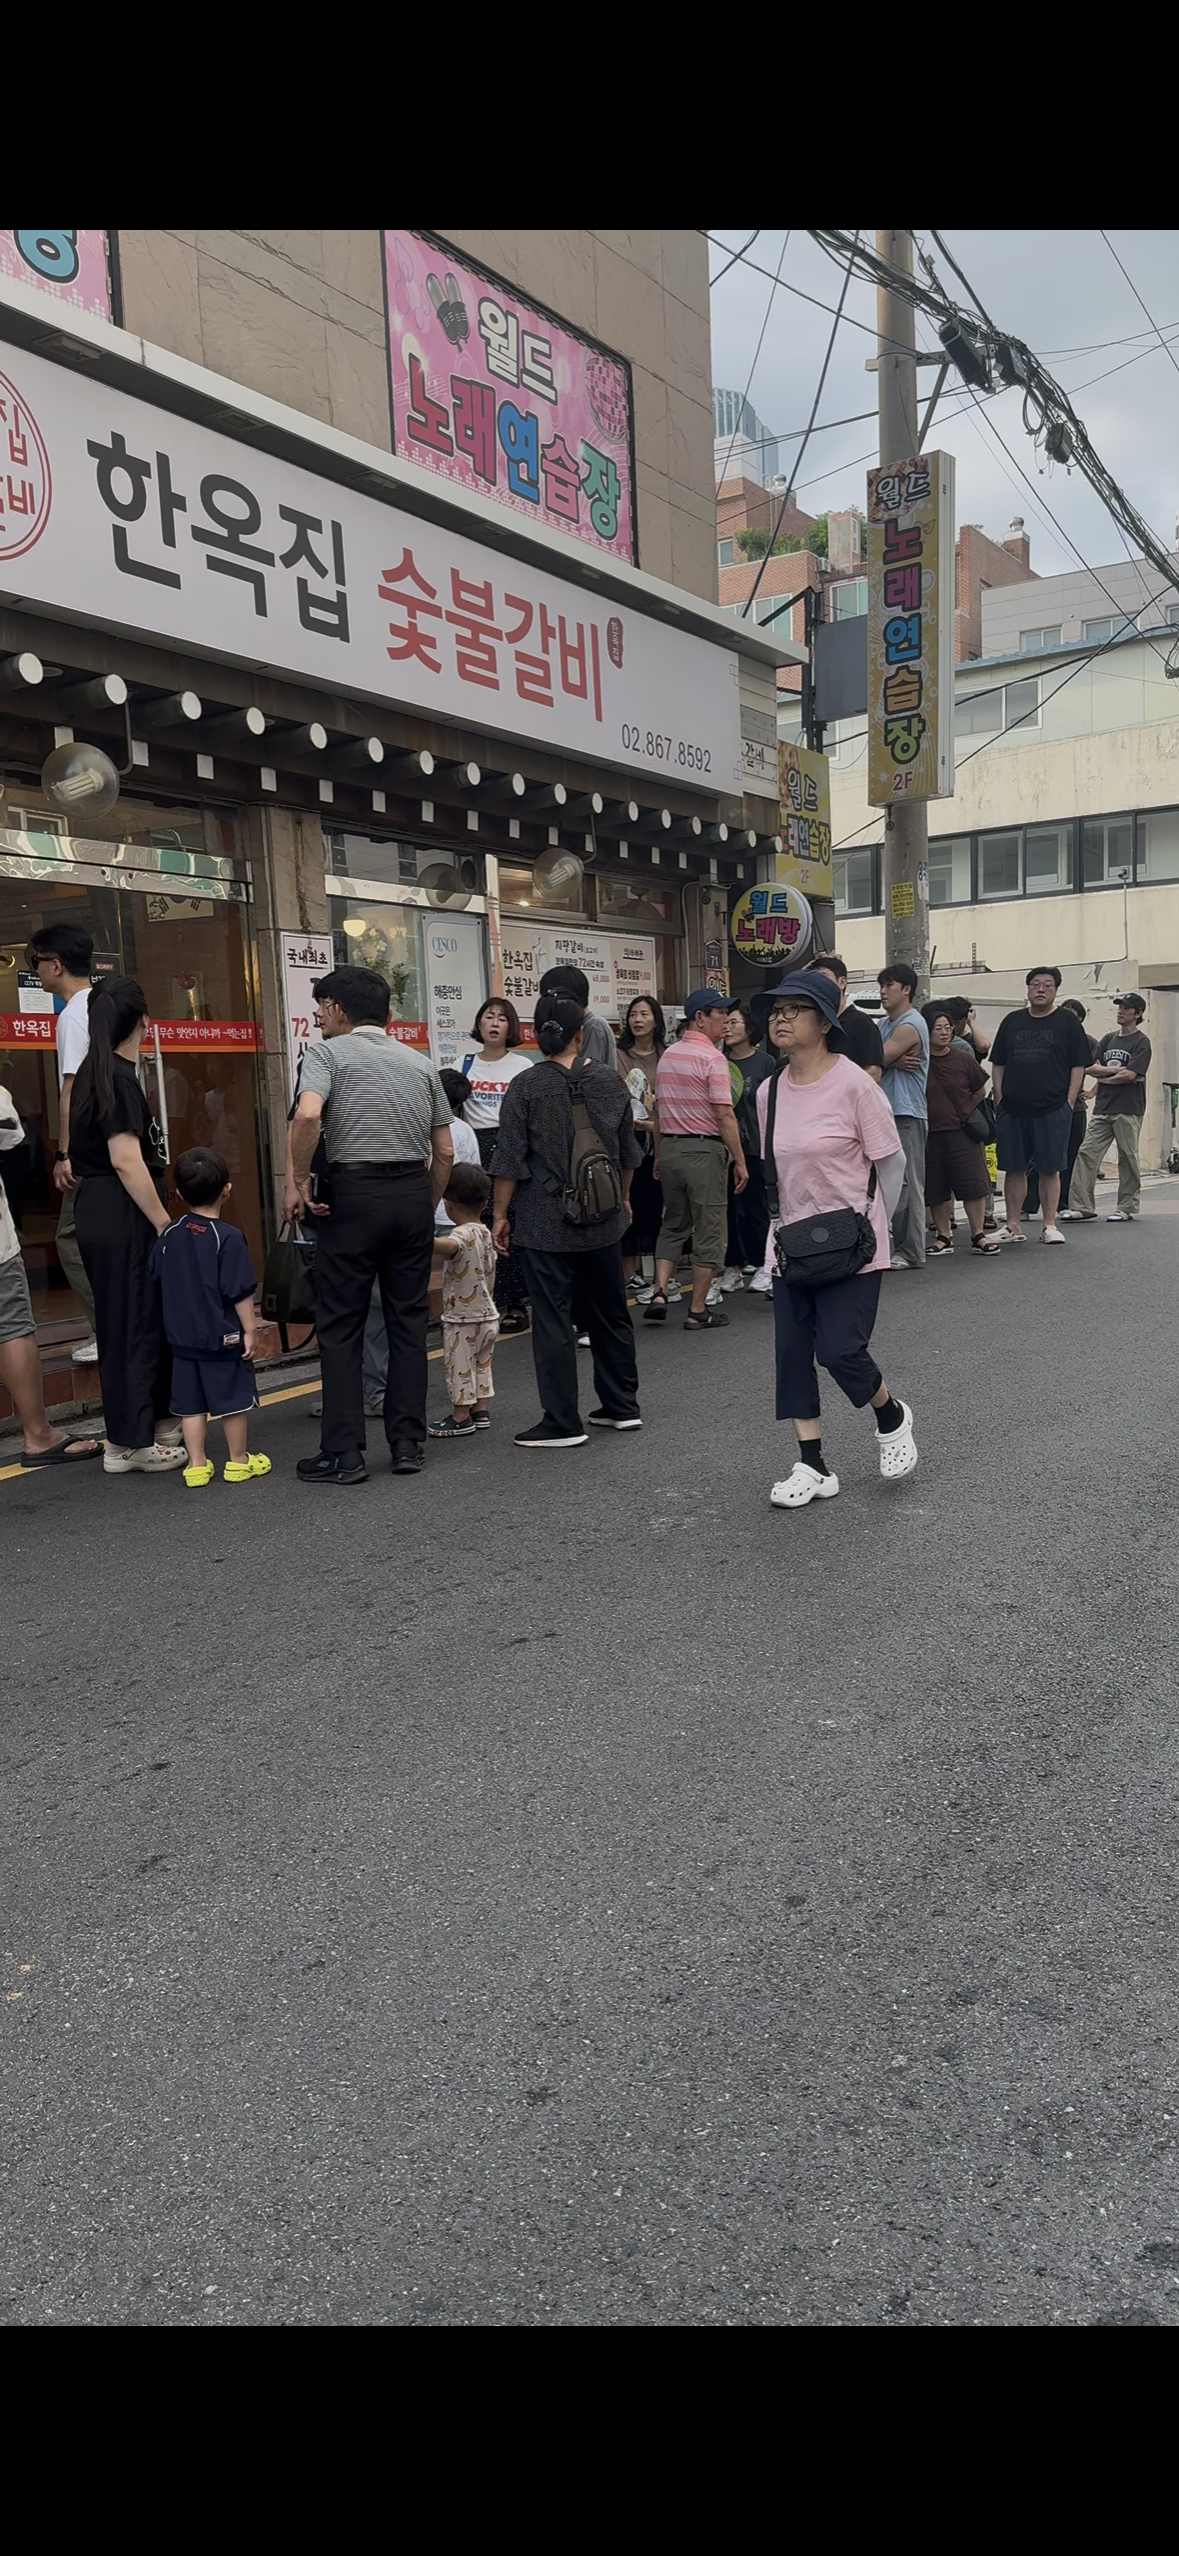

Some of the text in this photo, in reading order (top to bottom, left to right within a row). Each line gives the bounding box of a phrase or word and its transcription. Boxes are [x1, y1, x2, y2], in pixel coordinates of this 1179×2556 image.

[477, 296, 558, 404] 월드
[407, 353, 622, 541] 노래연습장
[876, 472, 930, 510] 월드
[86, 431, 603, 723] 한옥집 숯불갈비
[883, 517, 926, 764] 노래연습장
[621, 723, 712, 774] 02.867.8592
[787, 766, 818, 812] 월드
[892, 770, 913, 791] 2F
[801, 869, 810, 884] 2F
[750, 890, 788, 914] 월드
[735, 916, 801, 945] 노래방
[432, 937, 458, 952] CESCO
[287, 948, 329, 965] 국내최초
[502, 949, 533, 971] 한옥집
[433, 984, 462, 1000] 해충안심
[504, 975, 541, 997] 숯불갈비
[12, 1020, 51, 1037] 한옥집
[159, 1027, 175, 1039] 무슨
[199, 1027, 221, 1039] 아니까
[291, 1017, 310, 1037] 72
[469, 1092, 505, 1101] AVORITE
[470, 1080, 510, 1092] UCKY
